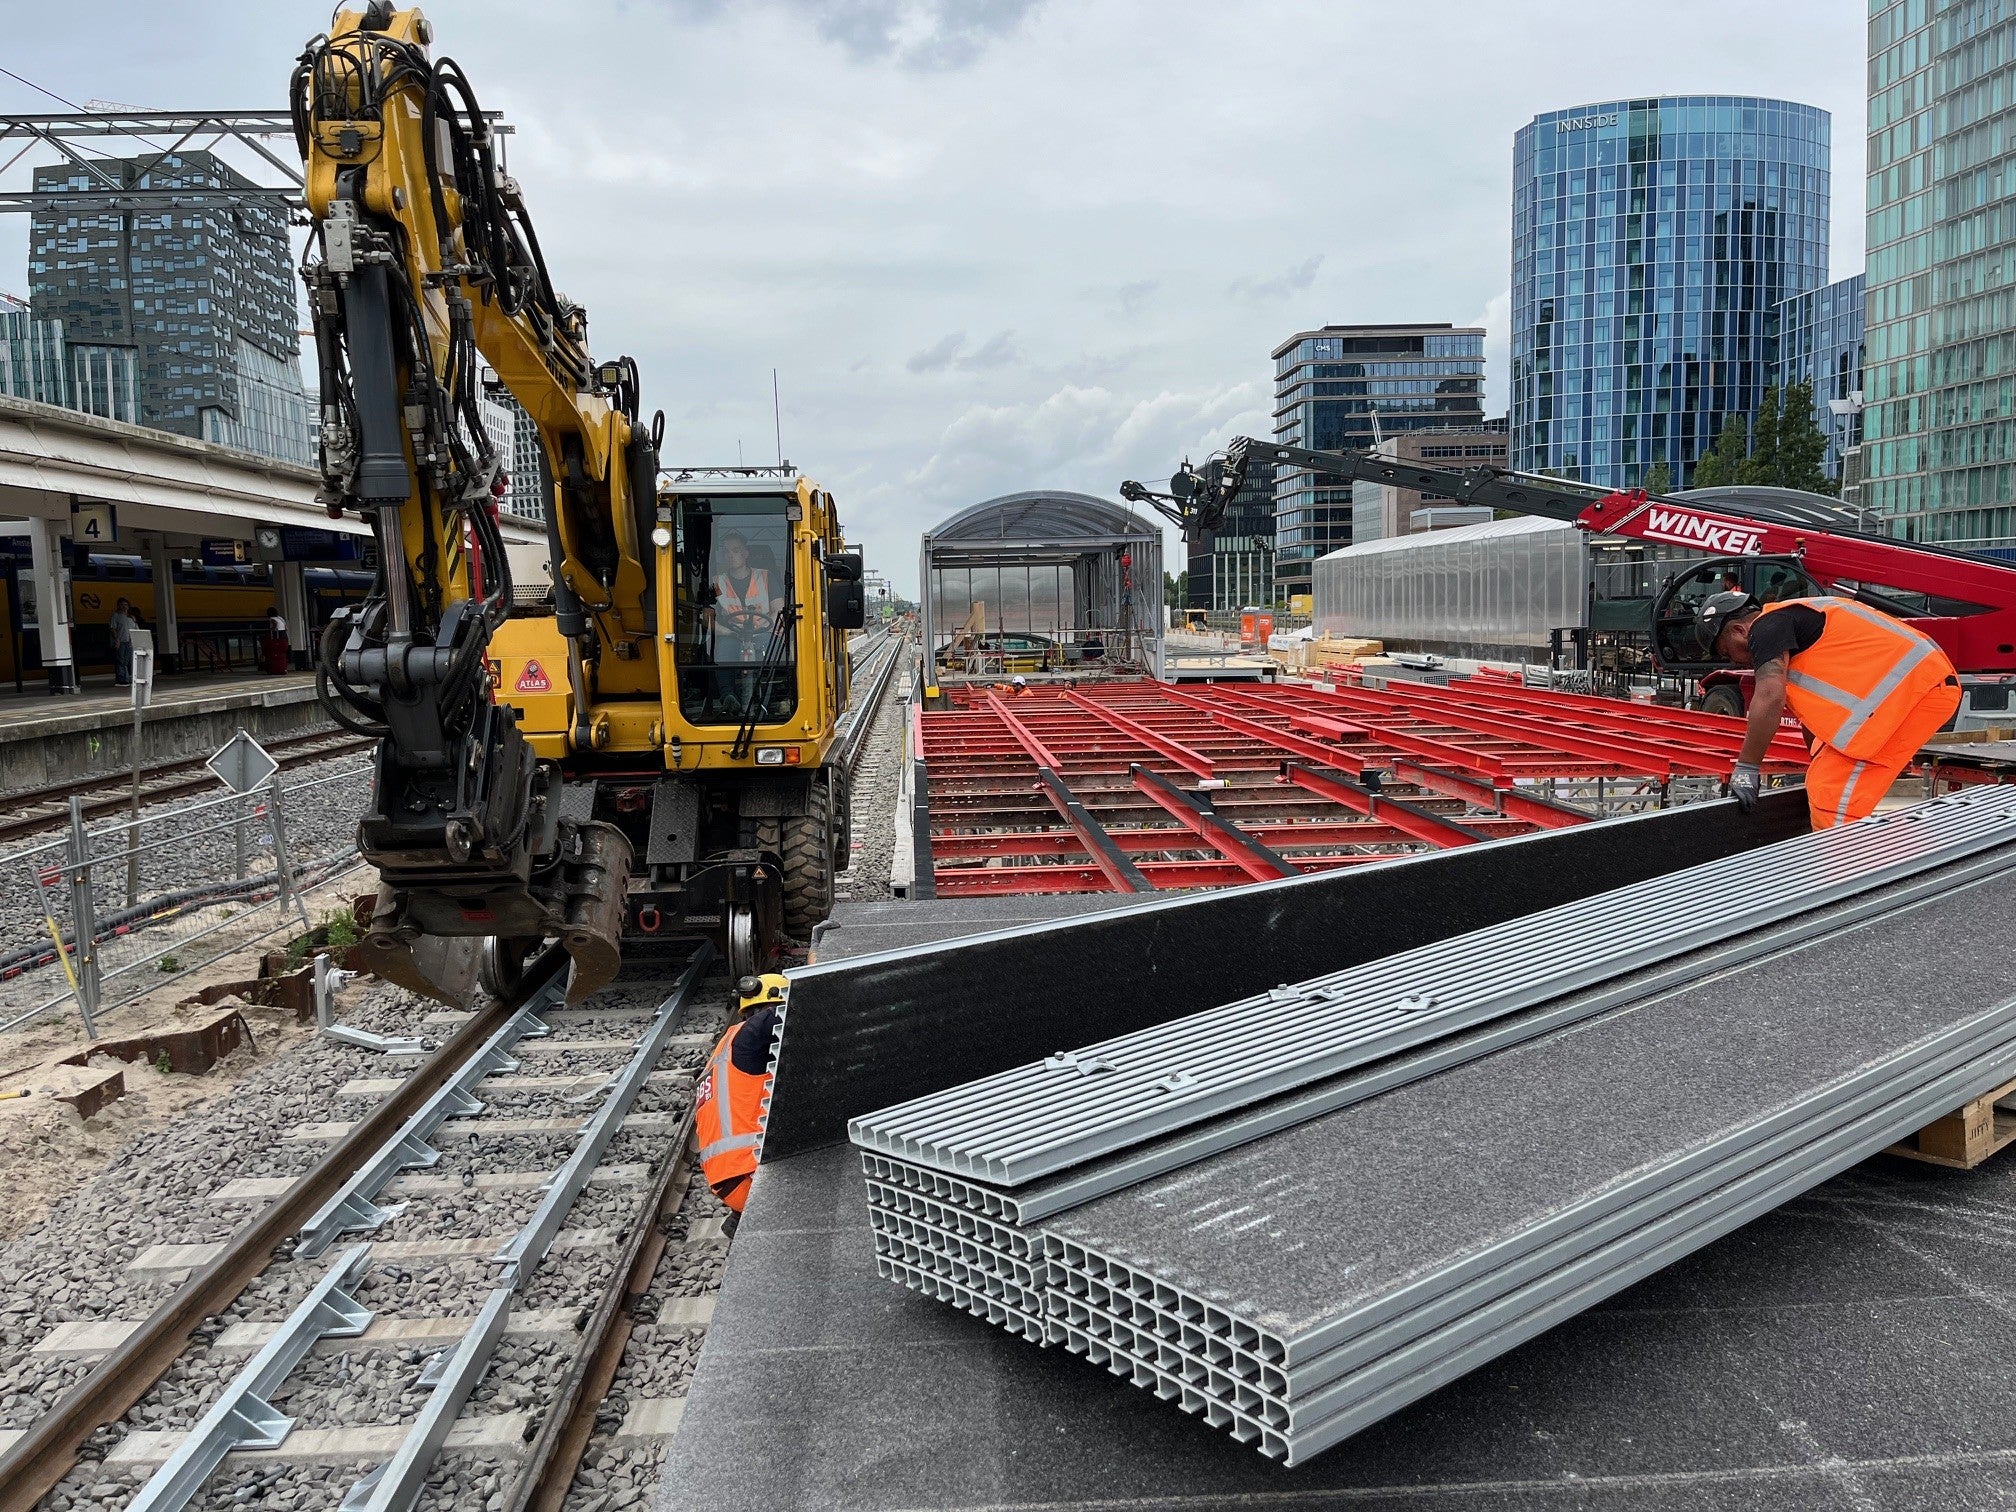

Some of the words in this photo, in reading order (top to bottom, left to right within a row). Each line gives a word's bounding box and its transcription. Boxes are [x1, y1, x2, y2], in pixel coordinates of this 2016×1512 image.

[84, 518, 101, 538] 4
[1648, 508, 1761, 556] WINKEL
[519, 679, 547, 689] ATLAS
